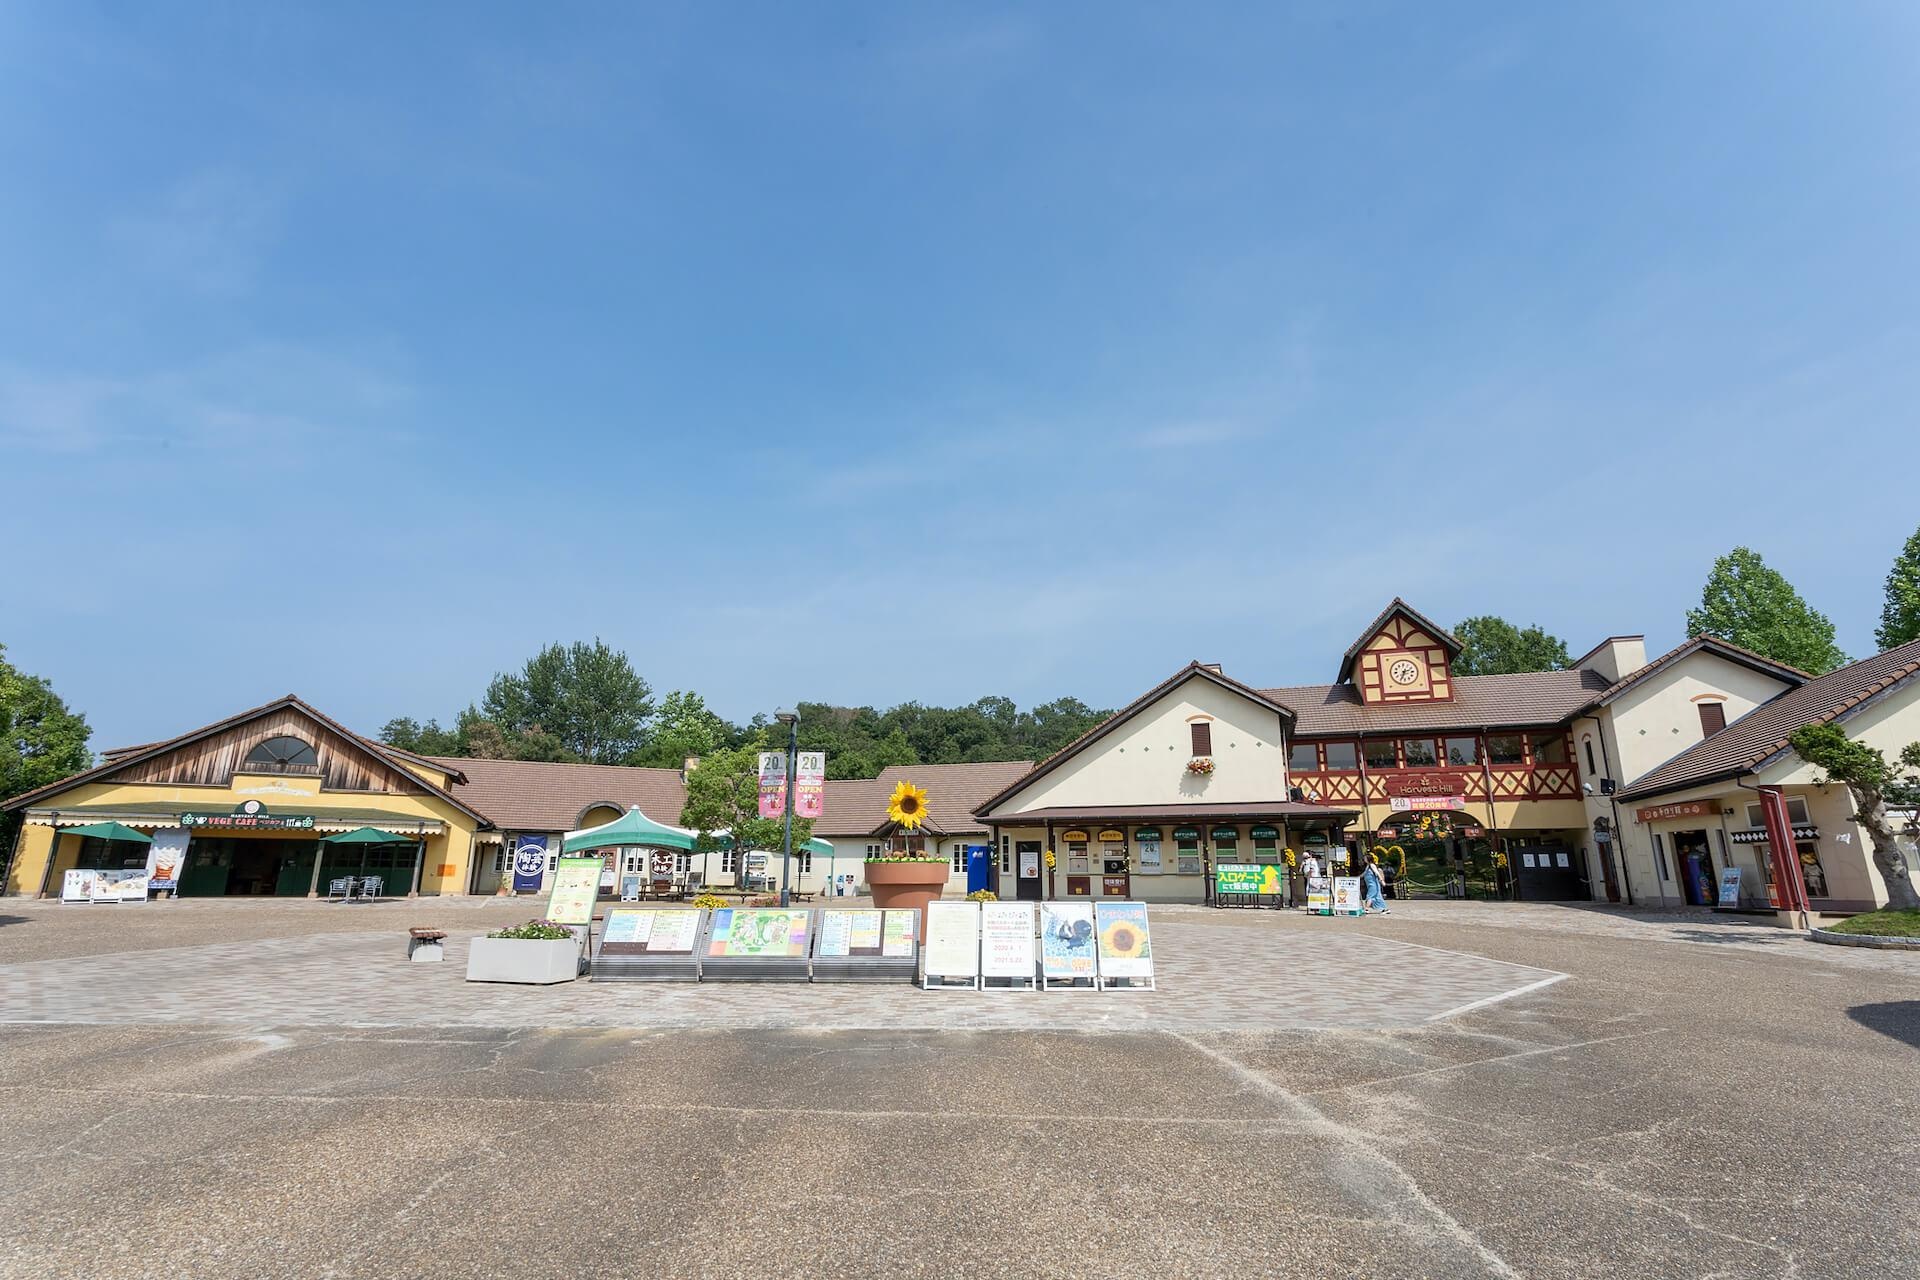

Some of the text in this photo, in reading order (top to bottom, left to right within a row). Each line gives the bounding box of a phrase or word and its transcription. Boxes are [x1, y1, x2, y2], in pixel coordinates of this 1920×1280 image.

[235, 818, 258, 826] CAFE
[518, 851, 544, 864] 陶芸
[651, 853, 672, 865] 木工
[1219, 872, 1262, 882] 入口ゲート
